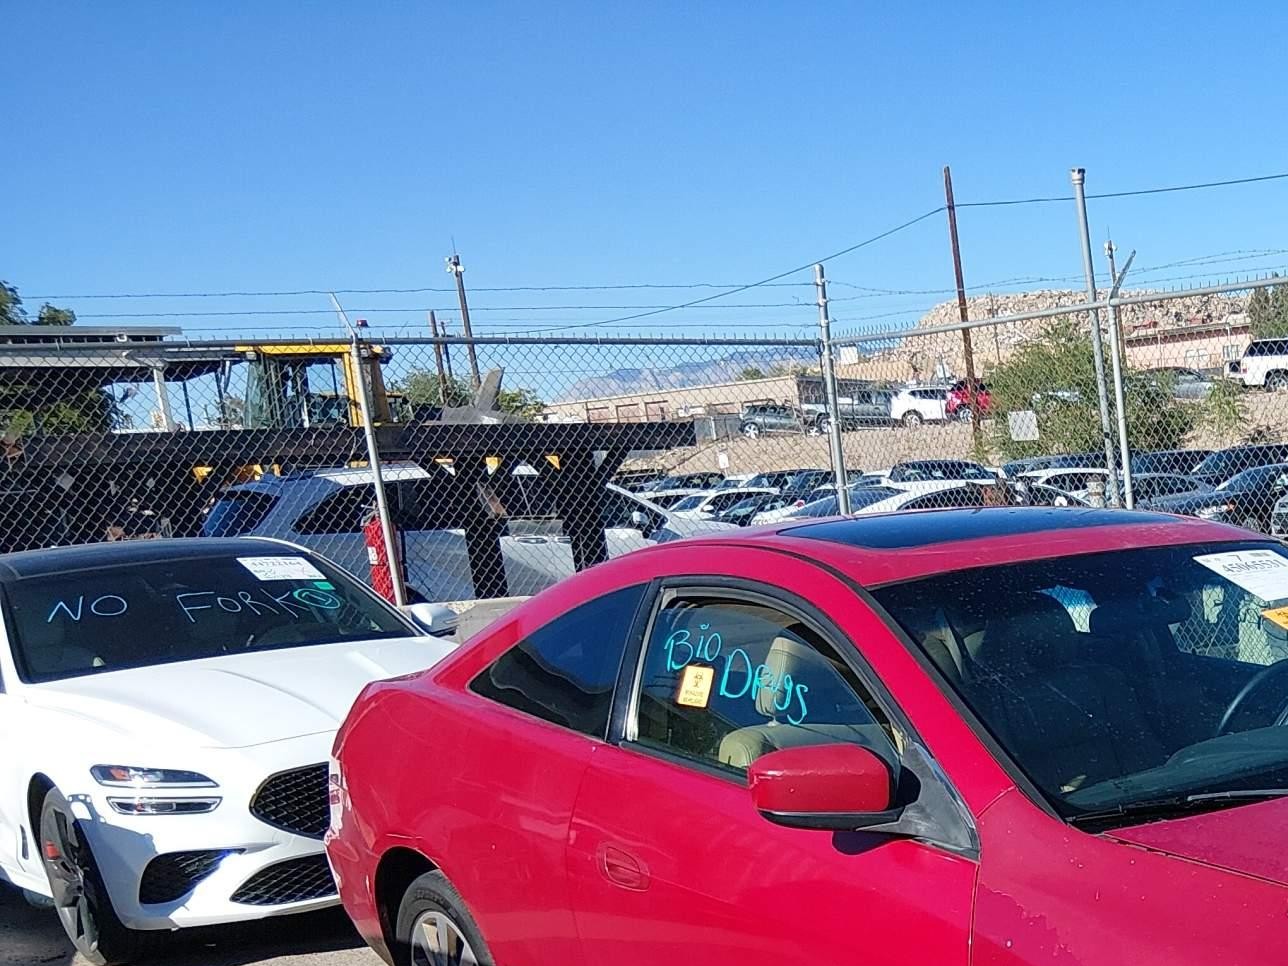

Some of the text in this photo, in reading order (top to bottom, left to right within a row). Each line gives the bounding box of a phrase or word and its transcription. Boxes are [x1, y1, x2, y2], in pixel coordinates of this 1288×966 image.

[1222, 559, 1287, 573] 45065531
[47, 588, 309, 623] NO FORK
